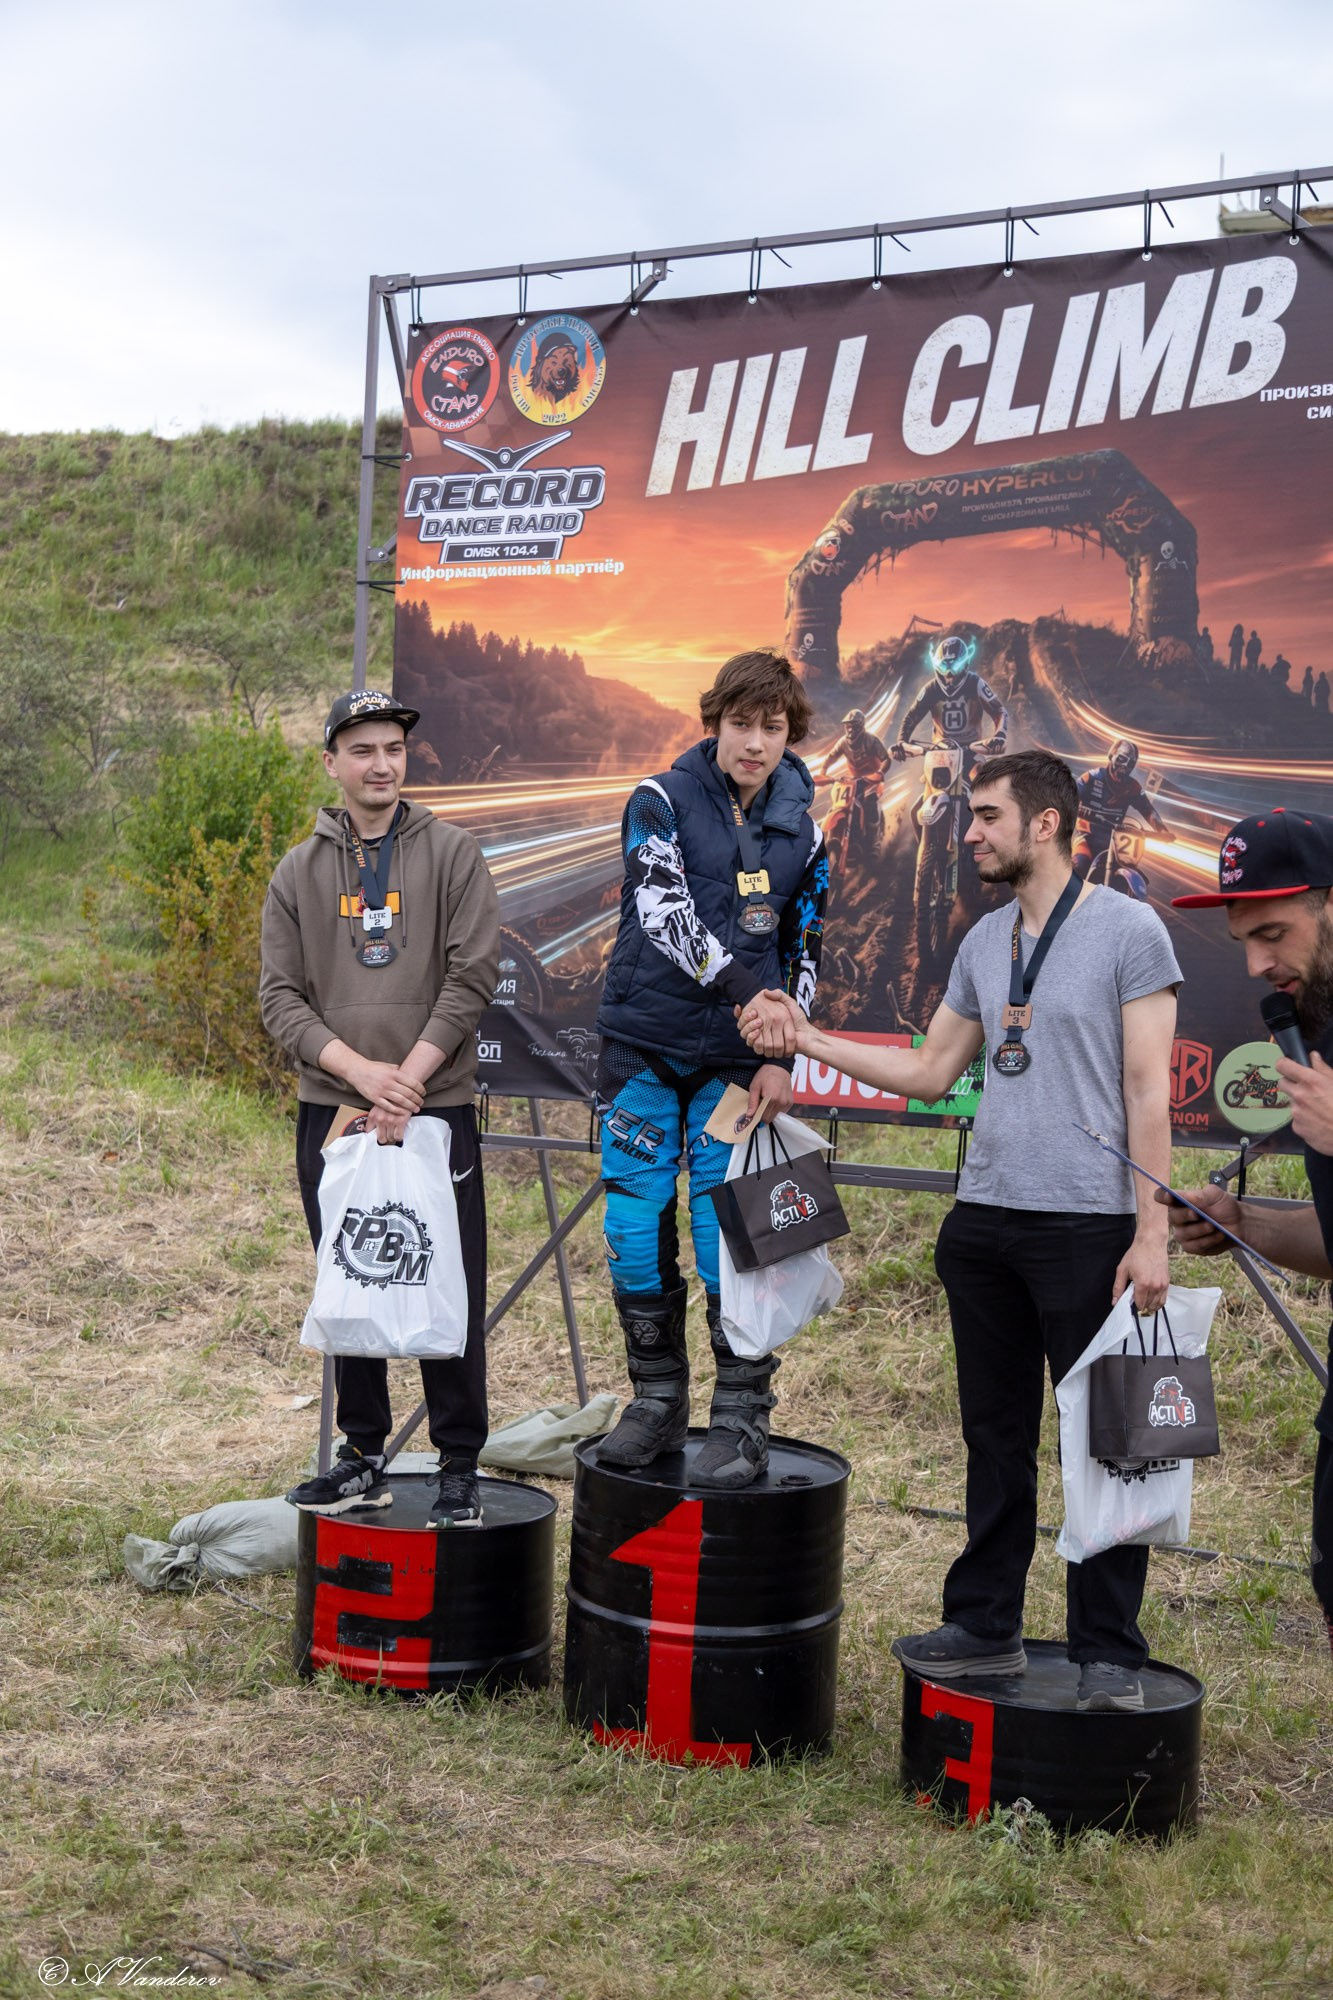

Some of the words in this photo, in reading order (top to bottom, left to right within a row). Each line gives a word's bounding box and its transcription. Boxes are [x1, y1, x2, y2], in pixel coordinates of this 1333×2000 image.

[430, 346, 485, 373] ENDURO
[645, 335, 873, 498] HILL
[901, 255, 1299, 456] CLIMB
[542, 412, 568, 423] 2022
[1307, 405, 1333, 419] СИ
[406, 469, 605, 515] RECORD
[424, 515, 504, 538] DANCE
[505, 512, 580, 534] RADIO
[463, 546, 500, 558] OMSK
[503, 545, 538, 557] 104.4
[401, 561, 552, 582] Информационный
[555, 559, 625, 577] партнёр
[349, 696, 391, 715] garage
[354, 846, 366, 868] HILL
[1118, 835, 1141, 858] 21
[1012, 1016, 1020, 1025] 3
[1246, 1081, 1280, 1092] ENDUR
[611, 1139, 659, 1165] RACING
[773, 1196, 815, 1227] ACTIVE
[1150, 1399, 1193, 1423] ACTIVE
[338, 1468, 374, 1497] 3M
[310, 1515, 438, 1690] 2
[592, 1498, 752, 1769] 1
